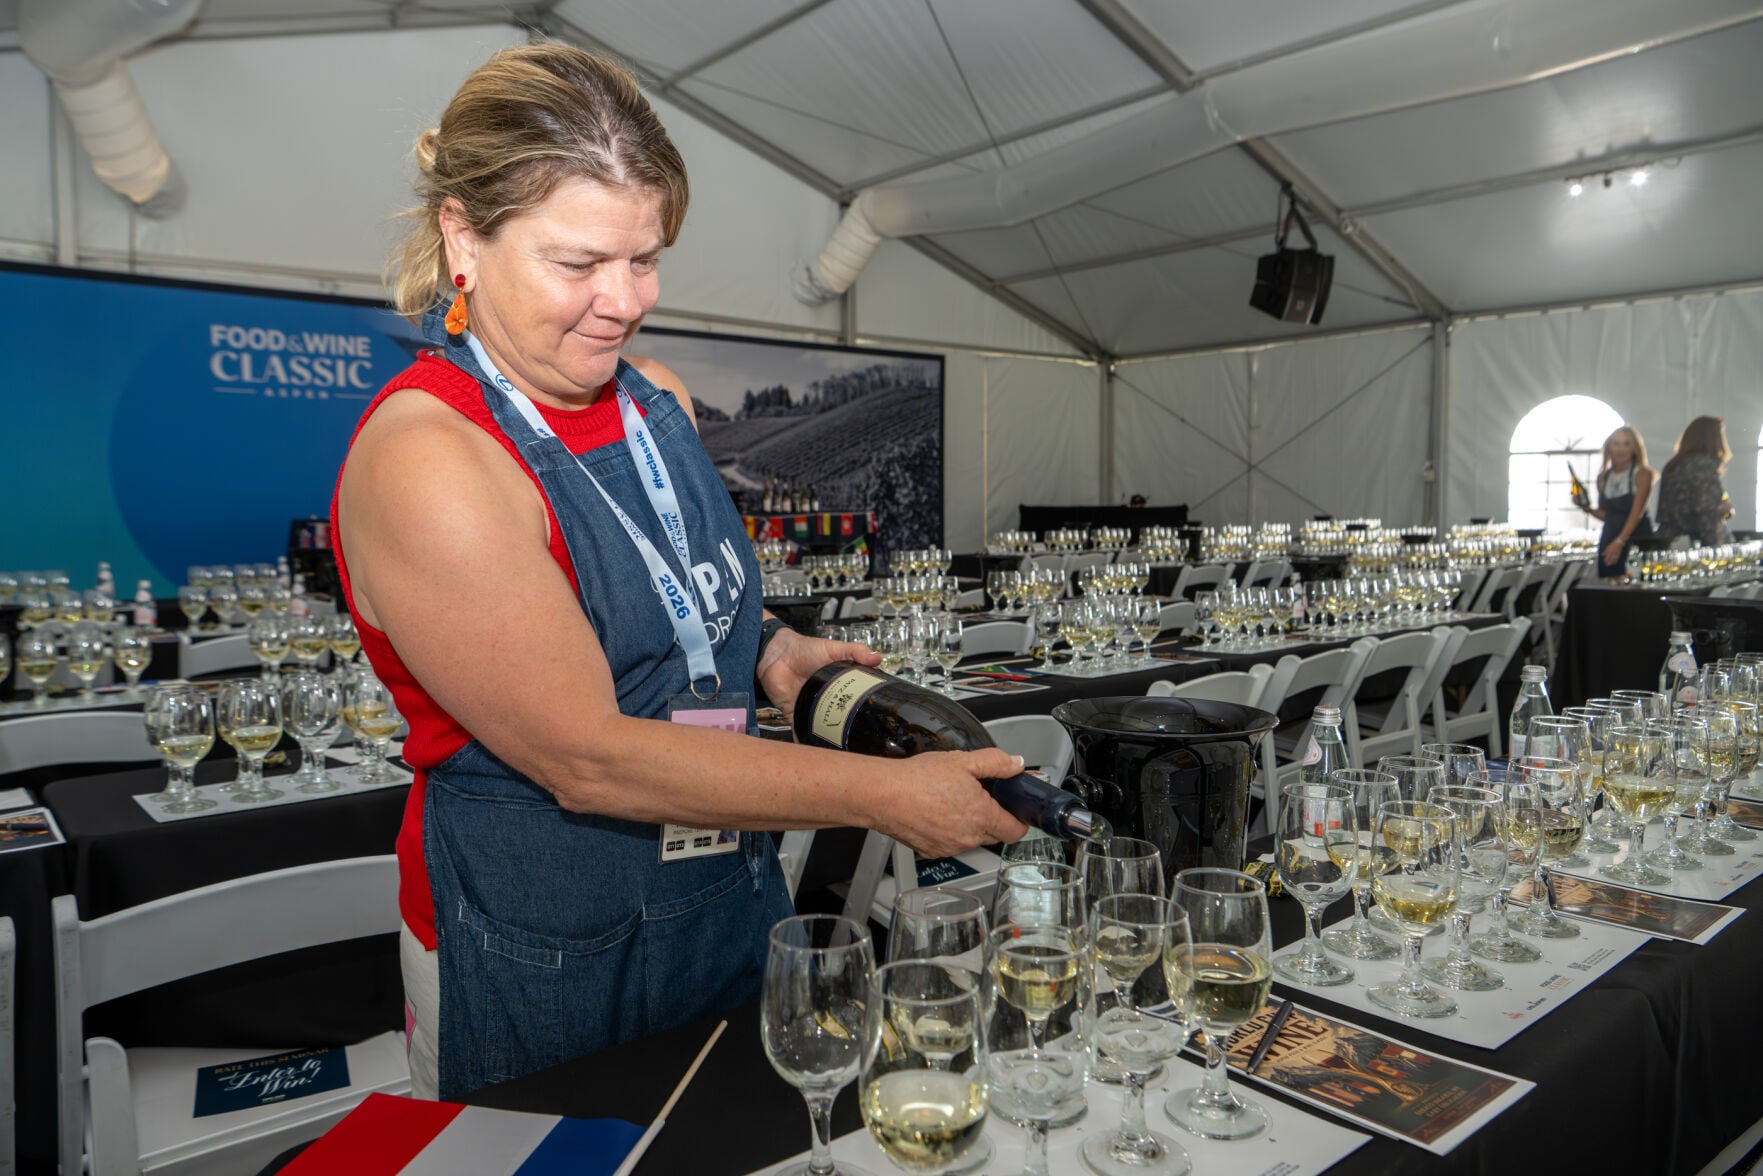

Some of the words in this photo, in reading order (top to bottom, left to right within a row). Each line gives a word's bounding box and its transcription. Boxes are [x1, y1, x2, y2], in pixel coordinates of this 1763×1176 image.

[209, 351, 373, 389] CLASSIC
[636, 430, 665, 490] #fwclassic
[659, 573, 690, 620] 2026
[214, 1063, 244, 1075] RATE
[217, 1065, 304, 1092] Enter
[301, 1058, 323, 1074] to
[257, 1066, 322, 1098] Win!
